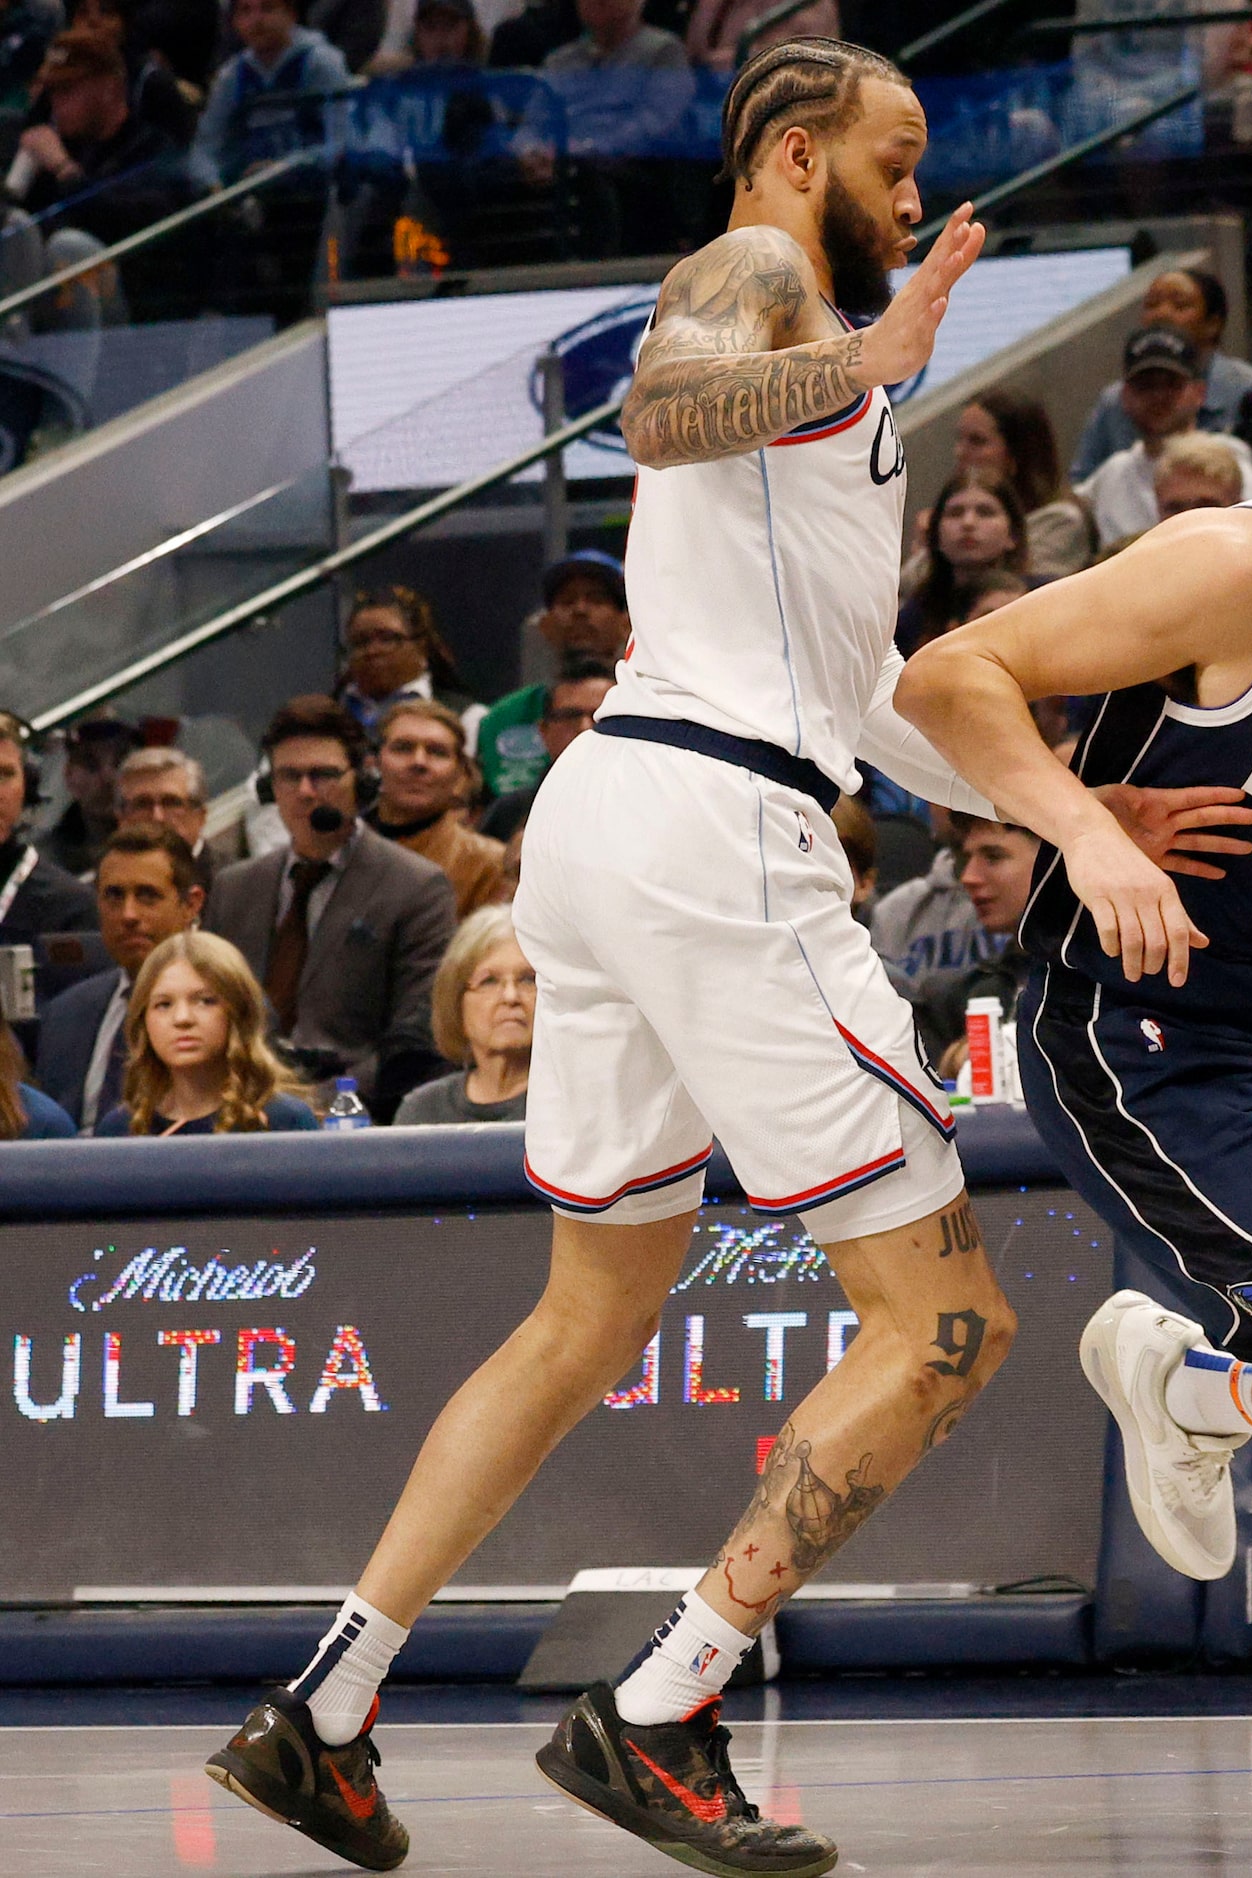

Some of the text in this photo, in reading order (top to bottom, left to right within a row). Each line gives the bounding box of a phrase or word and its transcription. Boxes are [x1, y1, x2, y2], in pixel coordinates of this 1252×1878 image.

[69, 1245, 317, 1312] Michelob
[13, 1325, 390, 1423] ULTRA
[925, 1308, 987, 1377] 9
